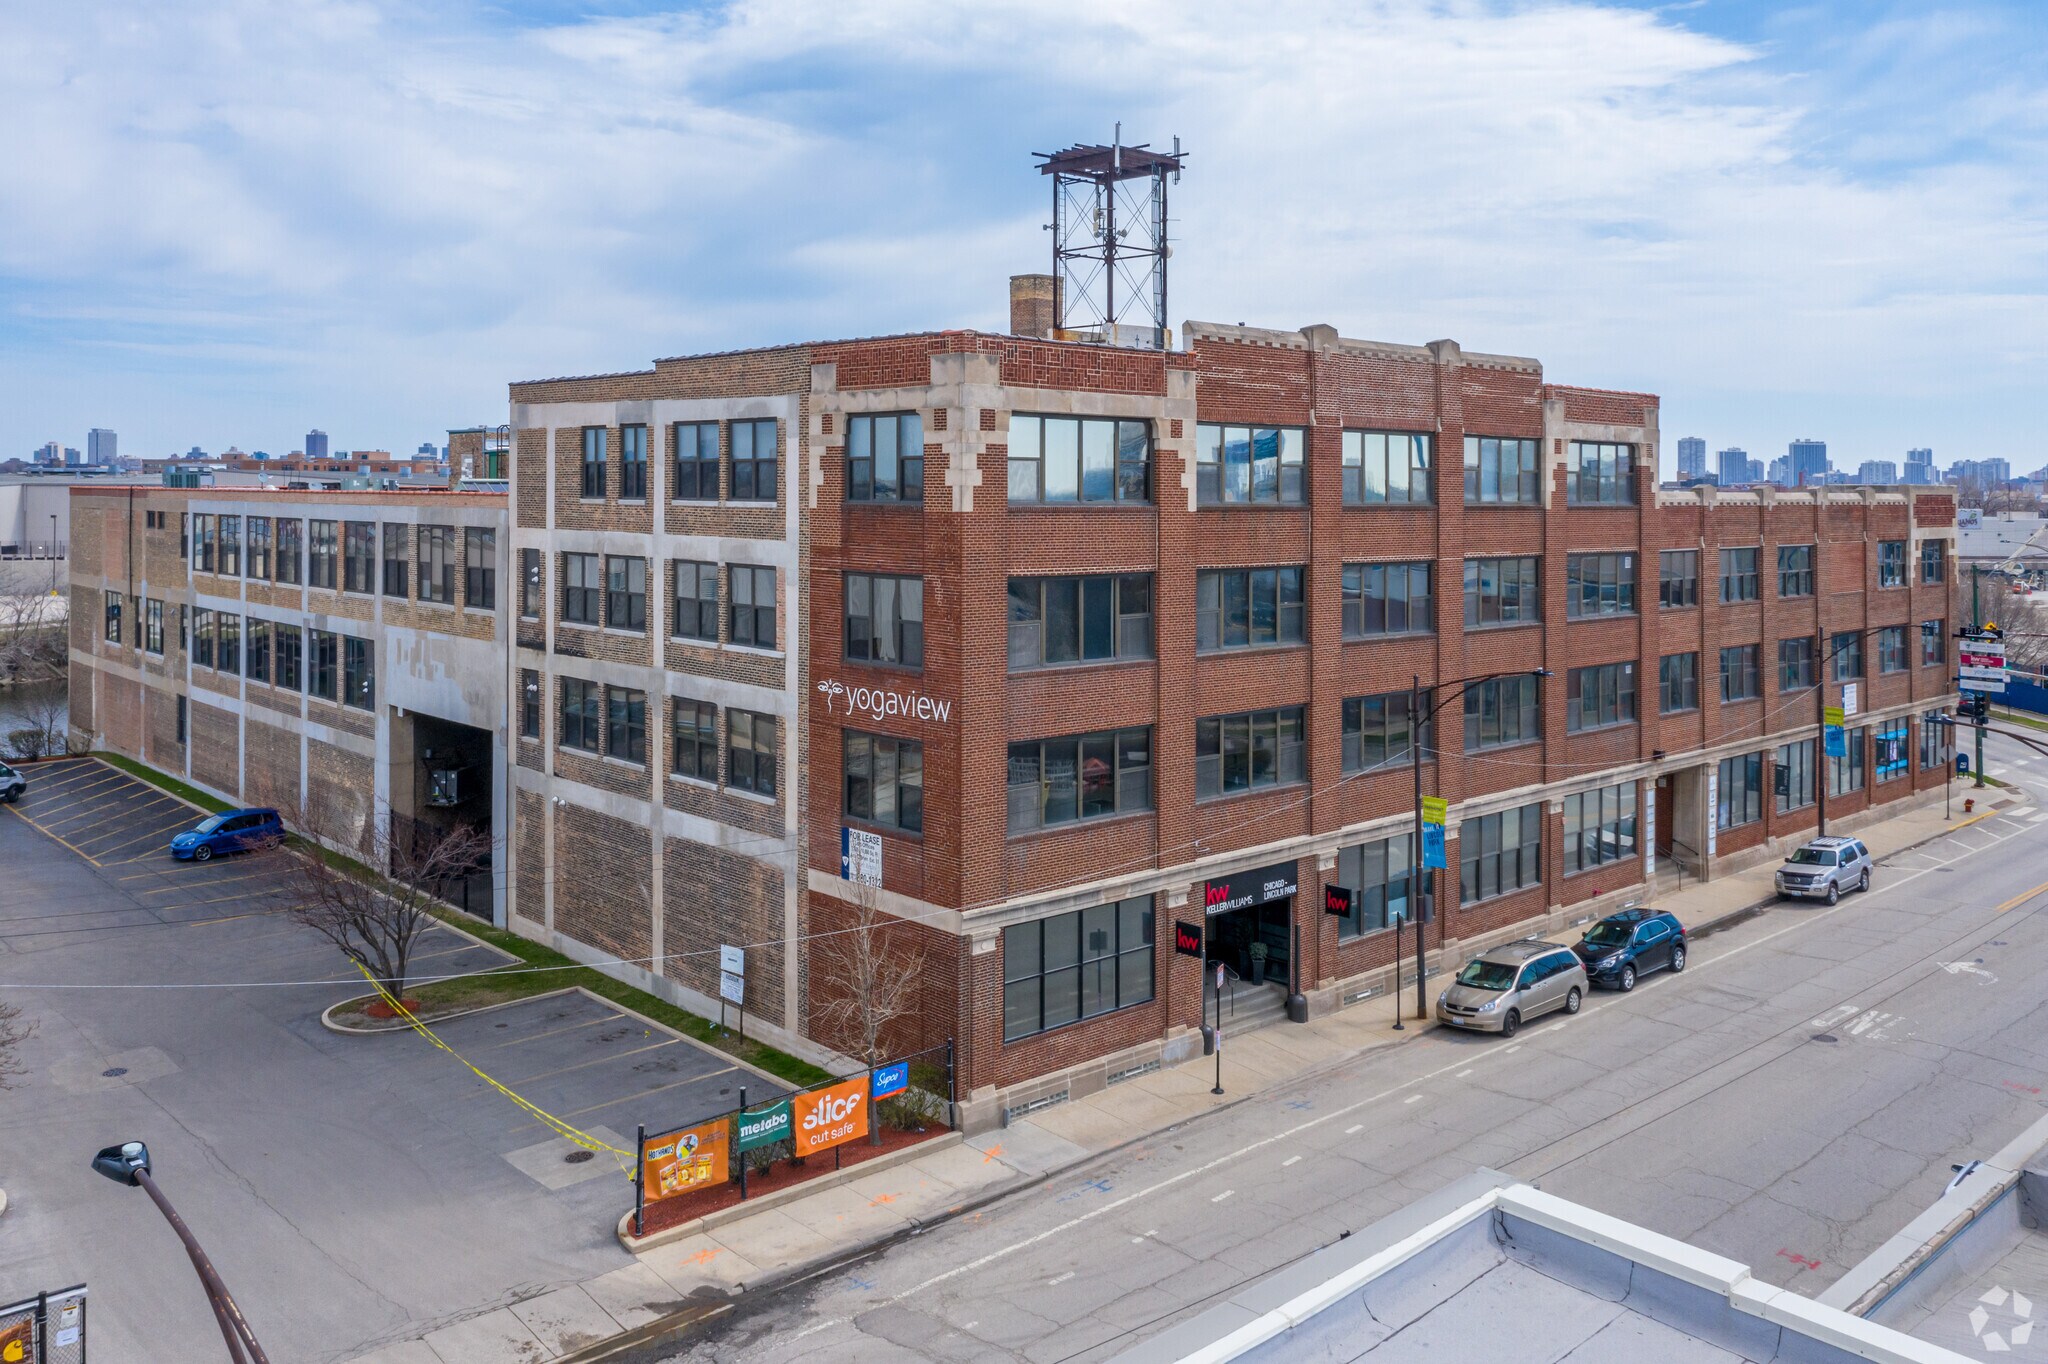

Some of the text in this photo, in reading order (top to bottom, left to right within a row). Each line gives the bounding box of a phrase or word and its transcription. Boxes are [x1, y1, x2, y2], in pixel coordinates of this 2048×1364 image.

[845, 686, 951, 723] yogaview
[861, 833, 880, 846] LEASE
[1206, 882, 1230, 906] kw
[1263, 879, 1285, 892] CHICAGO
[1263, 884, 1297, 900] LINCOLN PARK
[1327, 891, 1348, 911] kw
[1177, 928, 1199, 951] kw
[740, 1113, 788, 1137] metabo
[810, 1132, 829, 1145] cut
